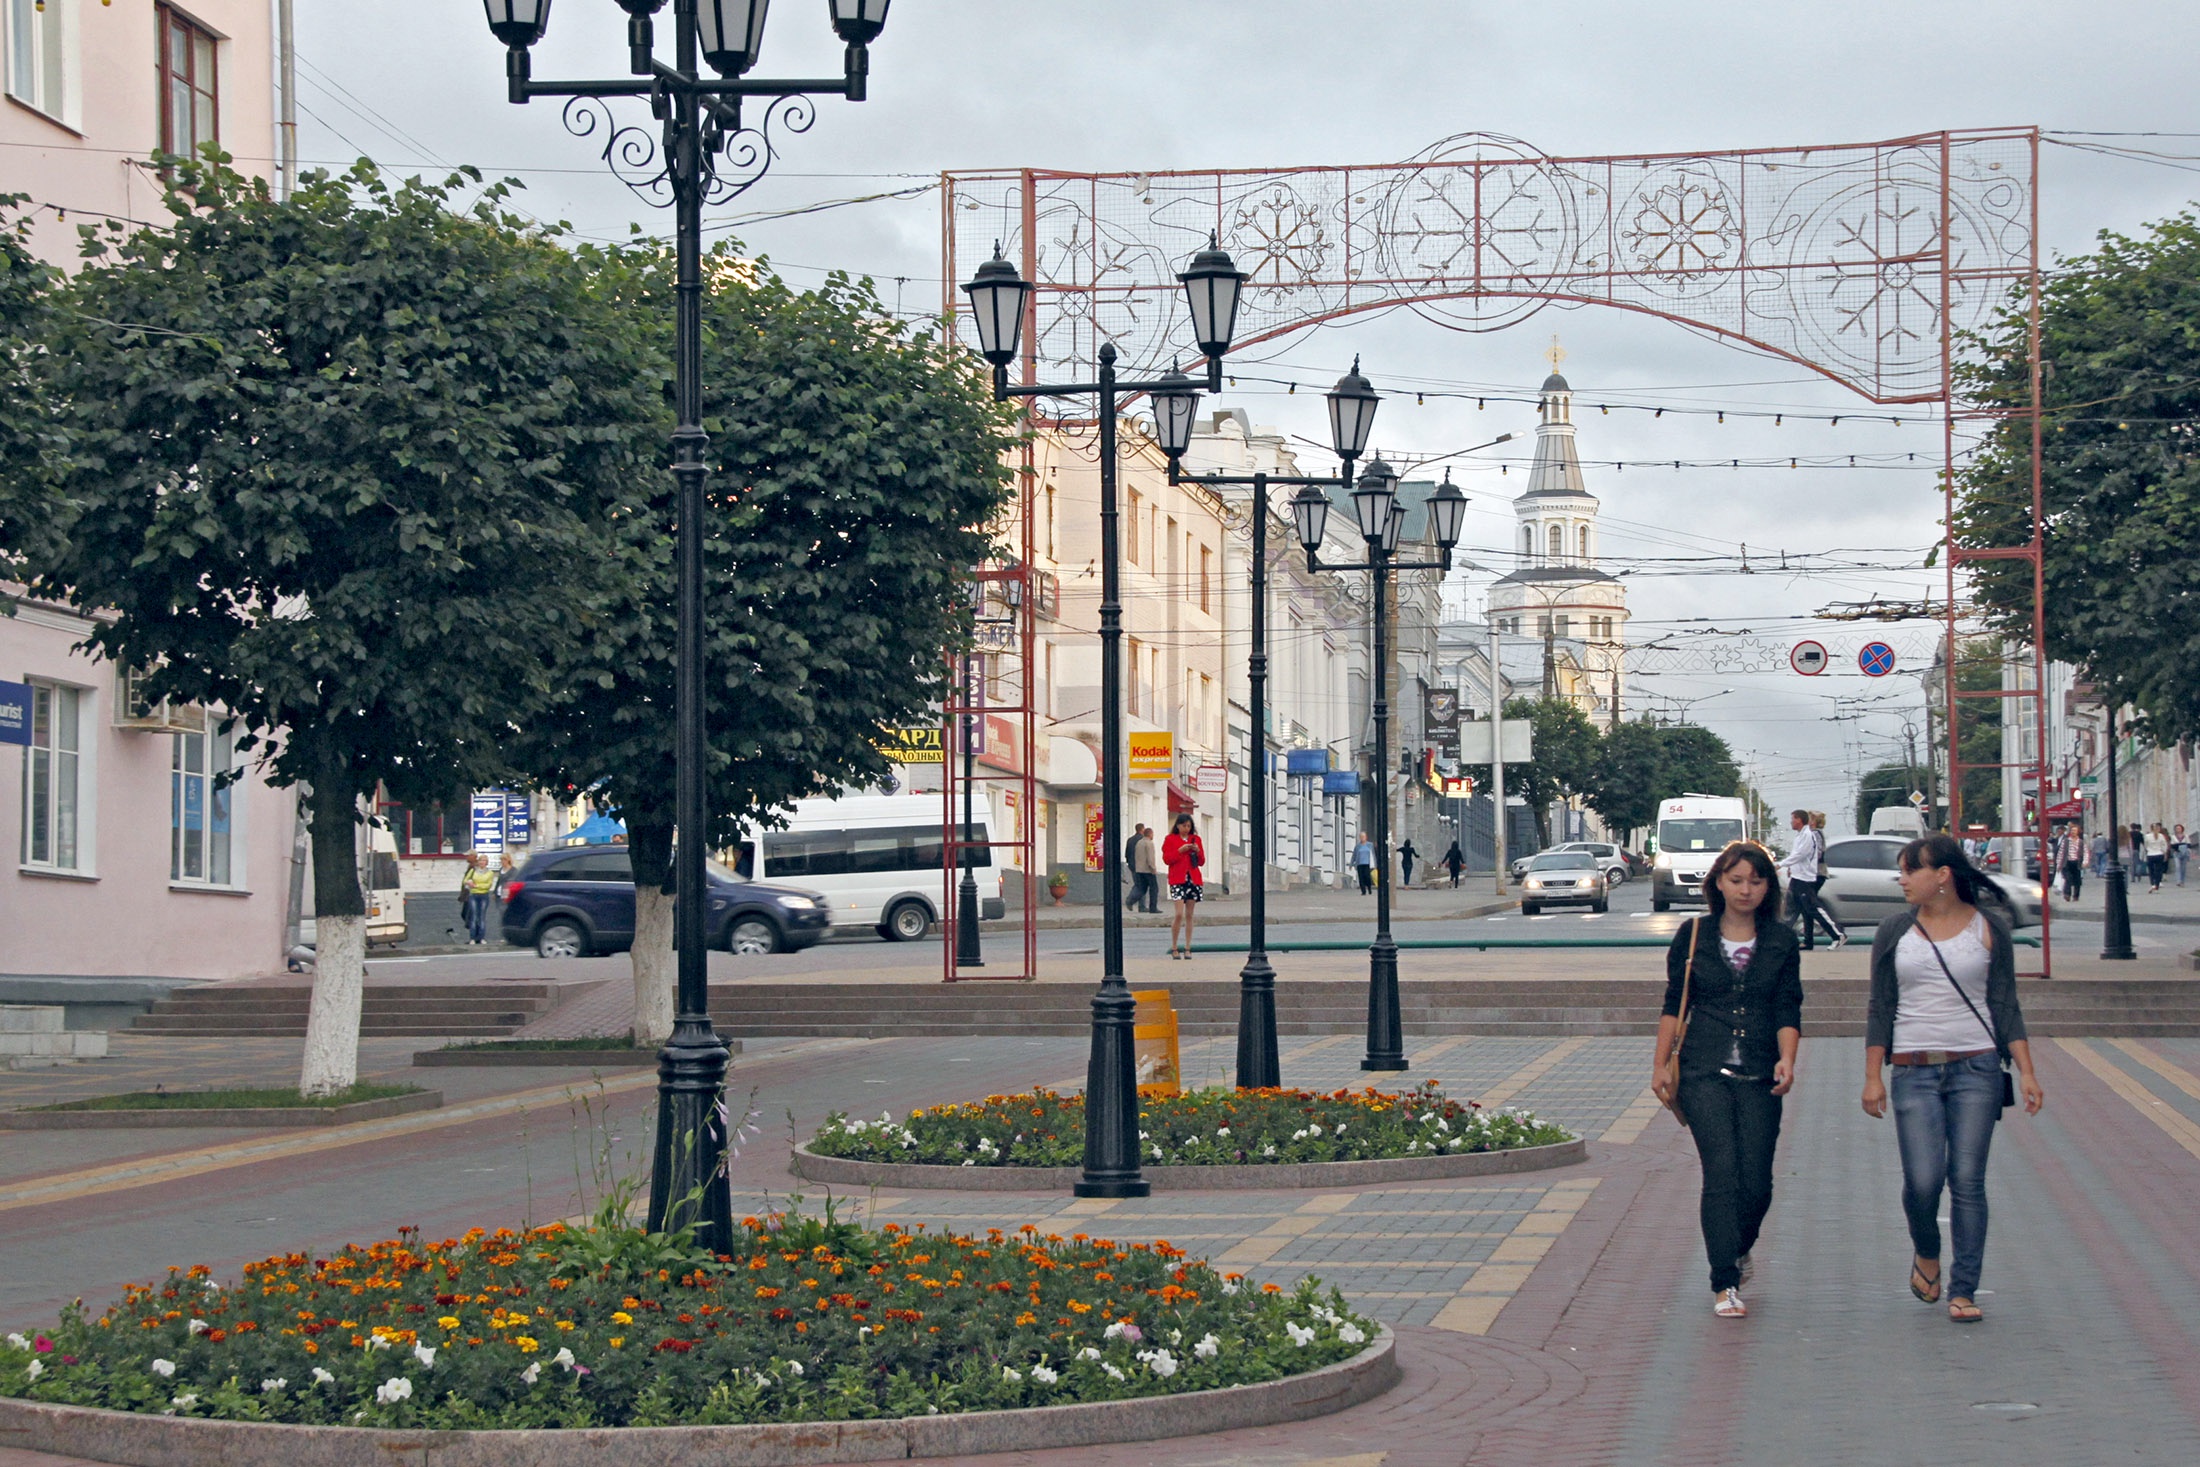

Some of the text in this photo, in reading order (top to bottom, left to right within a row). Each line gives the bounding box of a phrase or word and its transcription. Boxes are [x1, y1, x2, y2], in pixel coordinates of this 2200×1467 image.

[1132, 746, 1171, 757] Kodak
[1132, 756, 1171, 764] express
[1669, 805, 1684, 813] 54
[1086, 808, 1098, 867] ЦВЕТЫ
